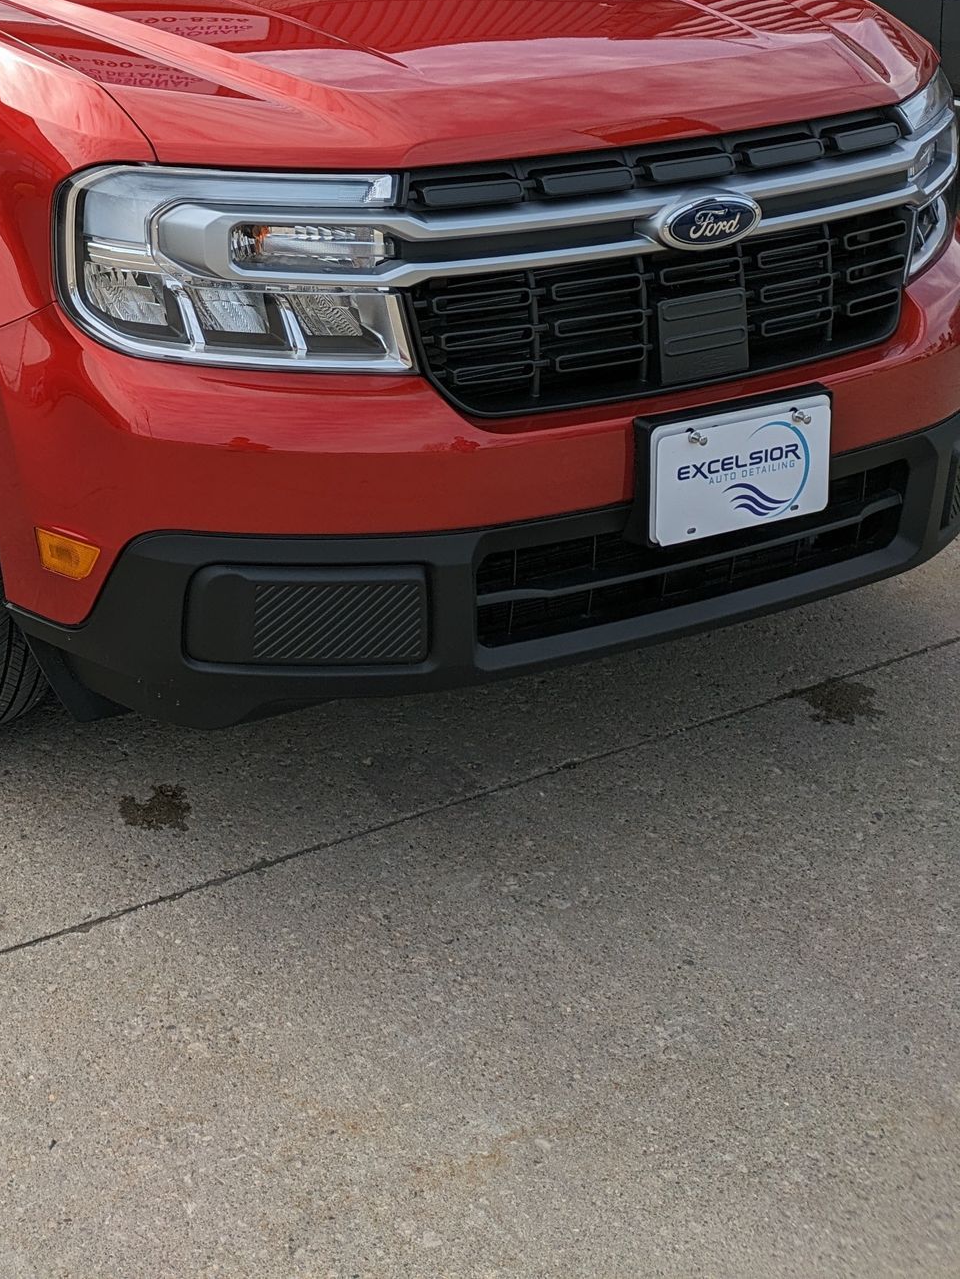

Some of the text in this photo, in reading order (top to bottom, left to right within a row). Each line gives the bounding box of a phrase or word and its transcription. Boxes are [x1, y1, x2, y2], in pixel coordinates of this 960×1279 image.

[689, 208, 741, 239] Ford
[677, 443, 802, 481] EXCELSIOR
[708, 459, 795, 485] AUTO DETAILING
